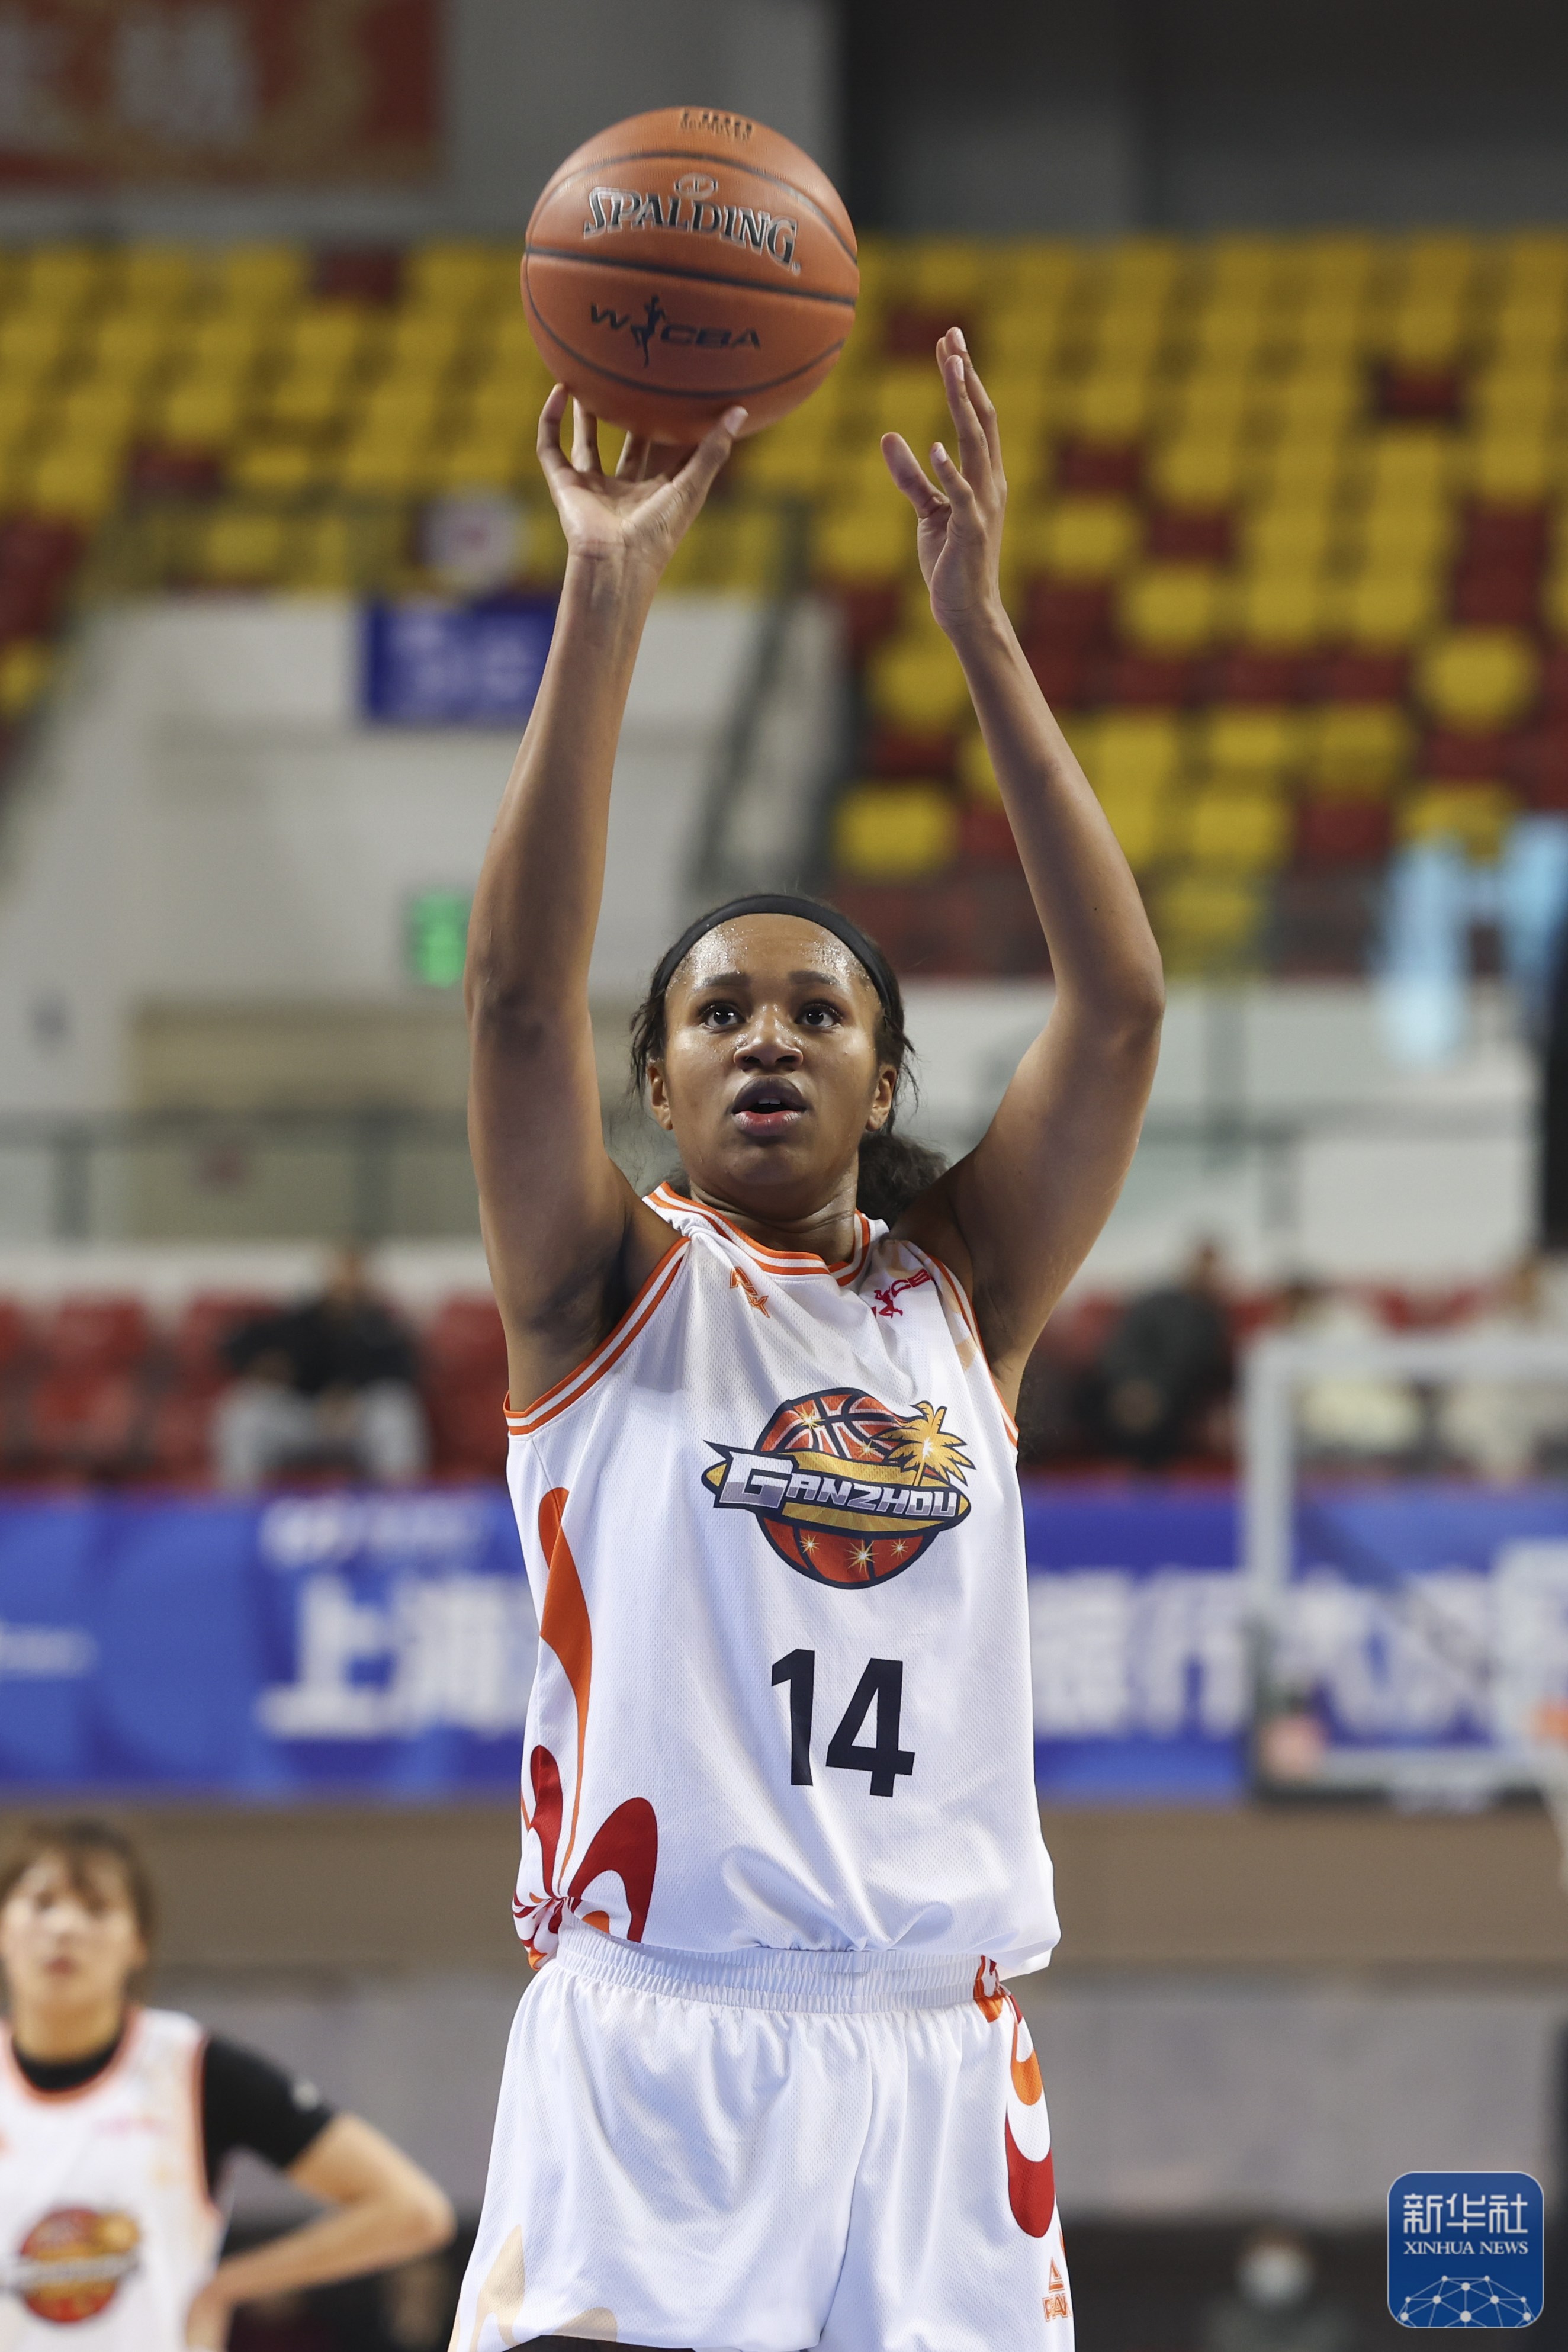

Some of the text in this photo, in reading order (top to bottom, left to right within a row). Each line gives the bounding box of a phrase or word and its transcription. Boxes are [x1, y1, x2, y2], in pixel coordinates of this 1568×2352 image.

[583, 185, 798, 271] SPALDING
[718, 1450, 958, 1518] GANZHOU
[771, 1648, 915, 1798] 14
